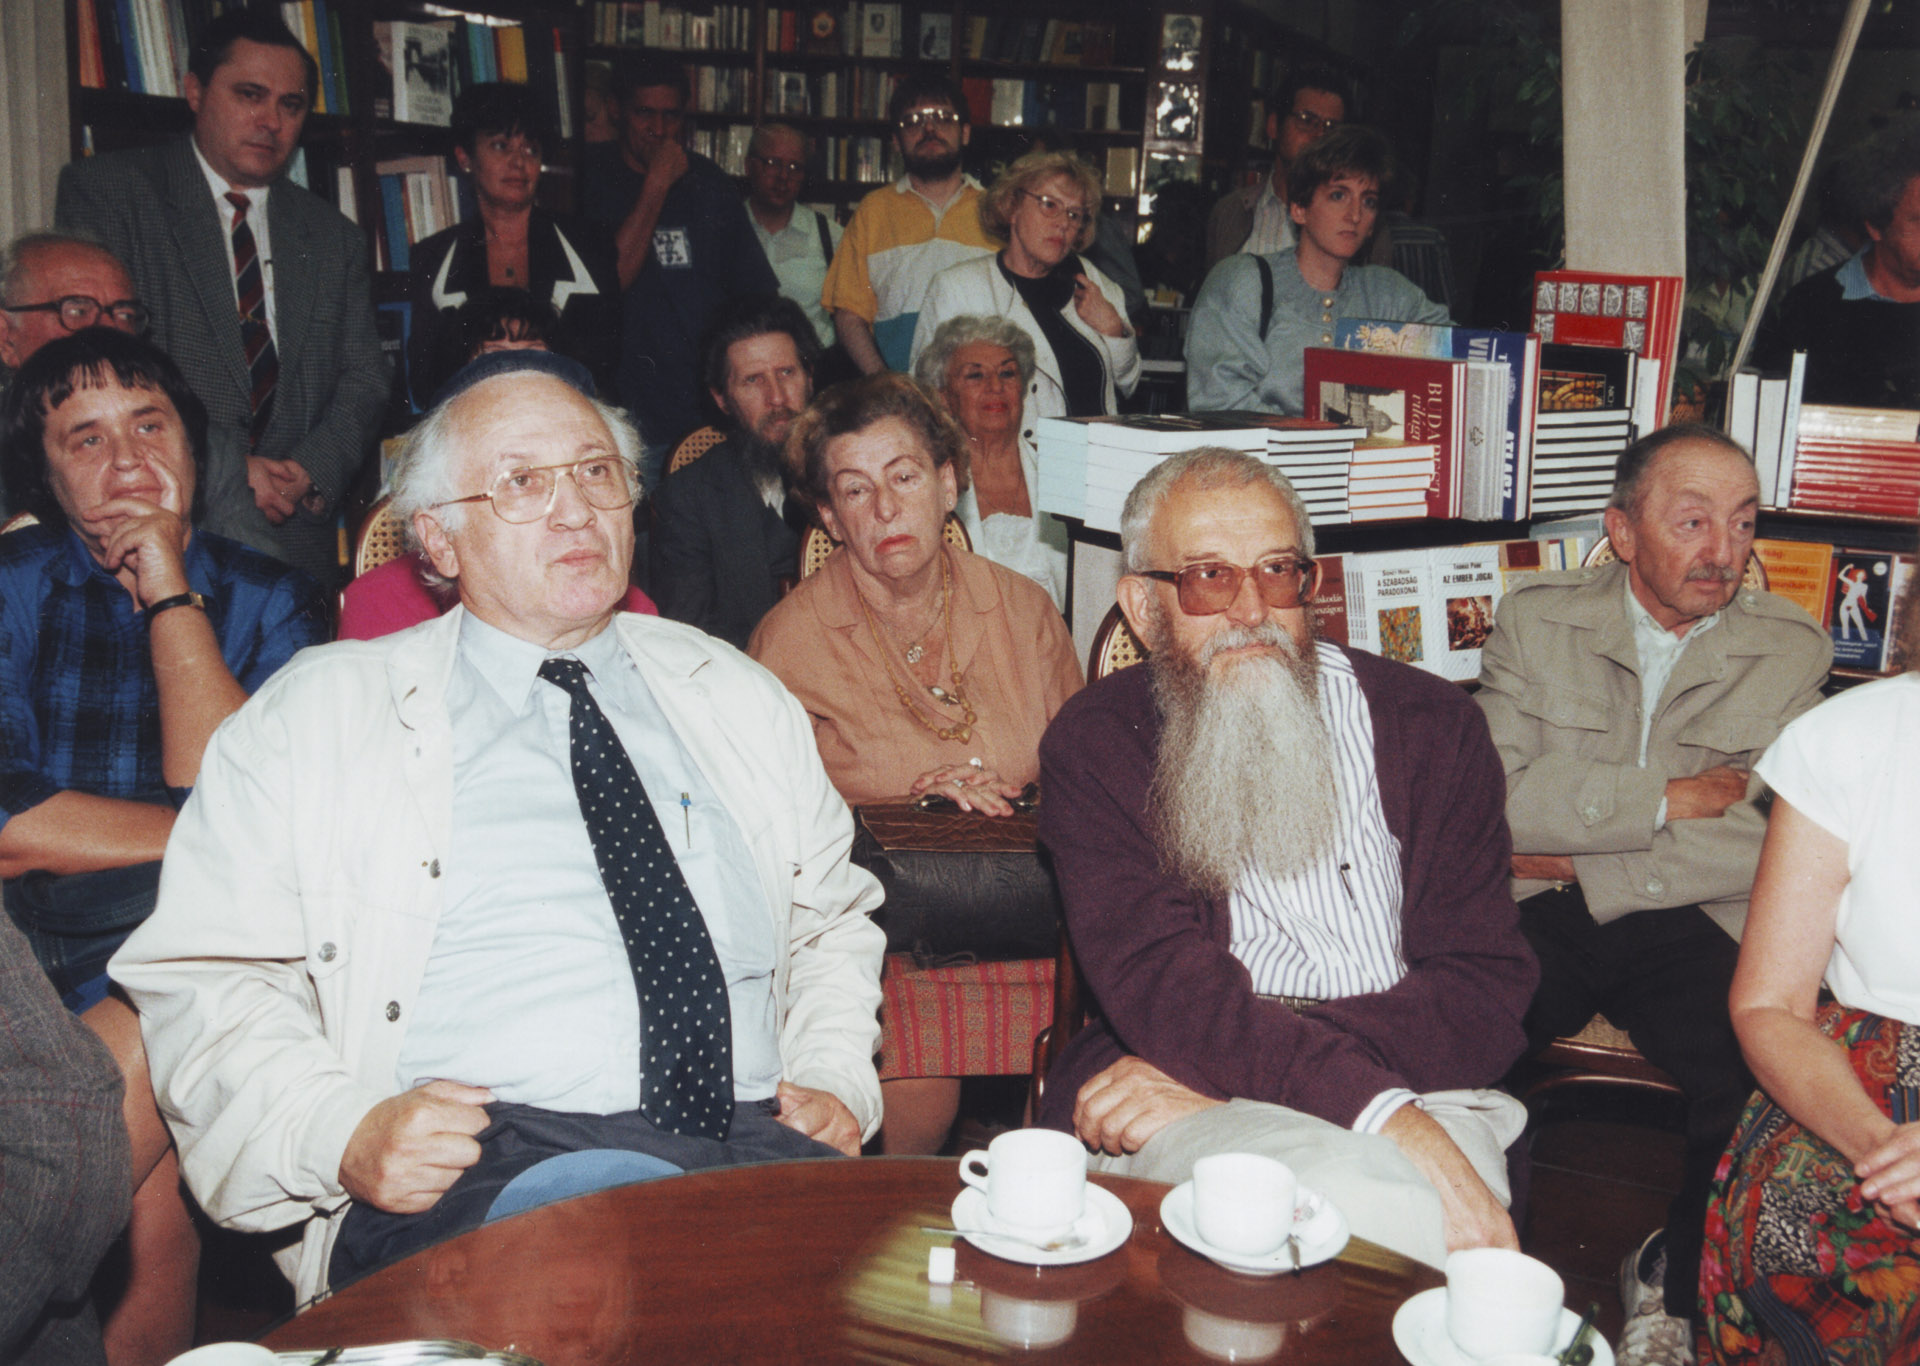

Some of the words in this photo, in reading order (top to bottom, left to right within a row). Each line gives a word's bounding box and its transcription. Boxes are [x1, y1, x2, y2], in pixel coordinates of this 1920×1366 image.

[1377, 579, 1382, 587] A
[1383, 576, 1418, 587] SZABADSÁG
[1443, 575, 1451, 583] AZ
[1452, 574, 1473, 582] EMBER
[1475, 572, 1494, 581] JOGAI
[1377, 586, 1418, 597] PARADOXONAI
